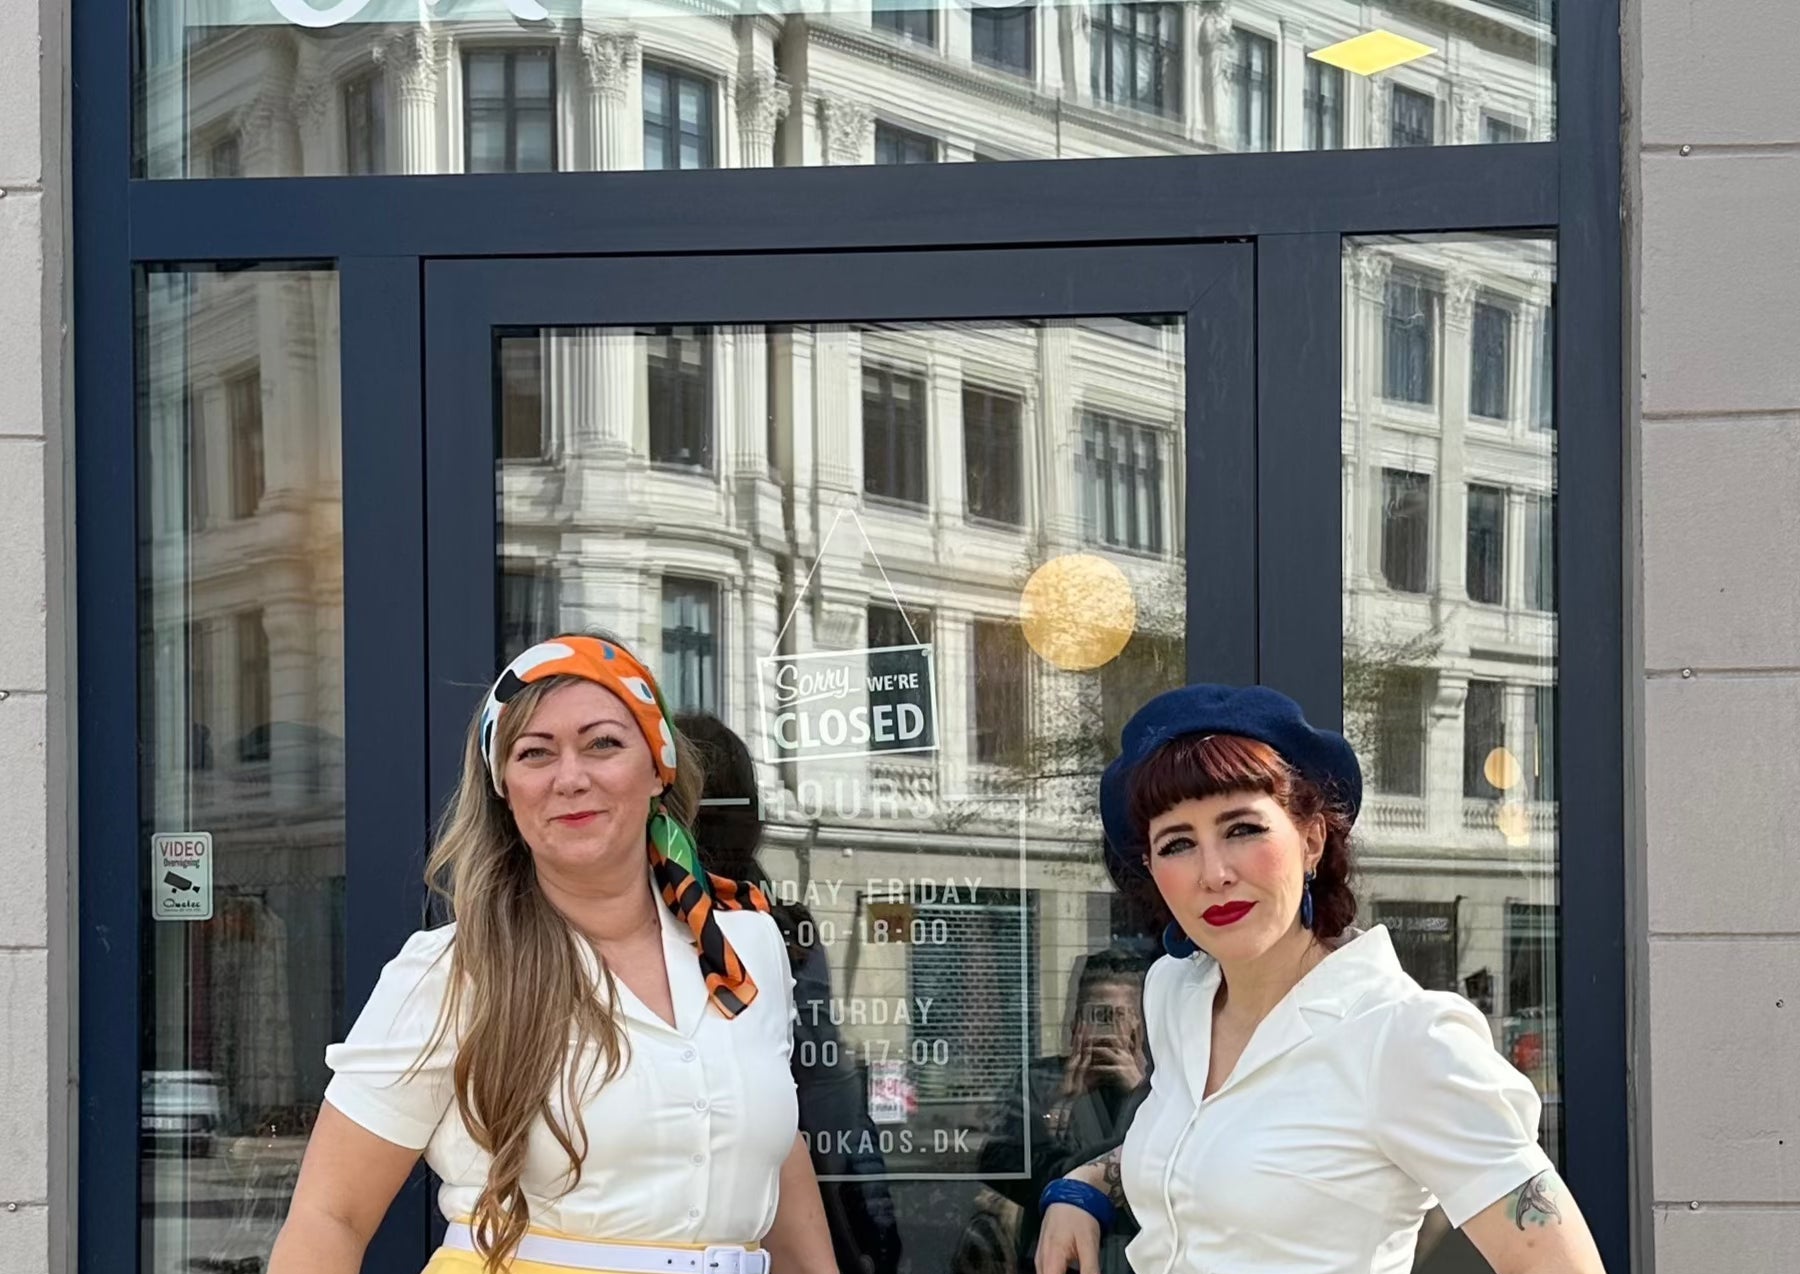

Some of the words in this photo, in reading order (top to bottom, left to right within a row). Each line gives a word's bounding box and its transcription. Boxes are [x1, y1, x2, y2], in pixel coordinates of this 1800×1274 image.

[774, 664, 862, 709] Sorry
[773, 703, 925, 749] CLOSED
[758, 779, 936, 821] HOURS
[160, 841, 205, 856] VIDEO
[760, 880, 843, 906] NDAY
[867, 877, 982, 904] FRIDAY
[783, 918, 948, 946] :00-18:00
[800, 1039, 949, 1066] 00-17:00
